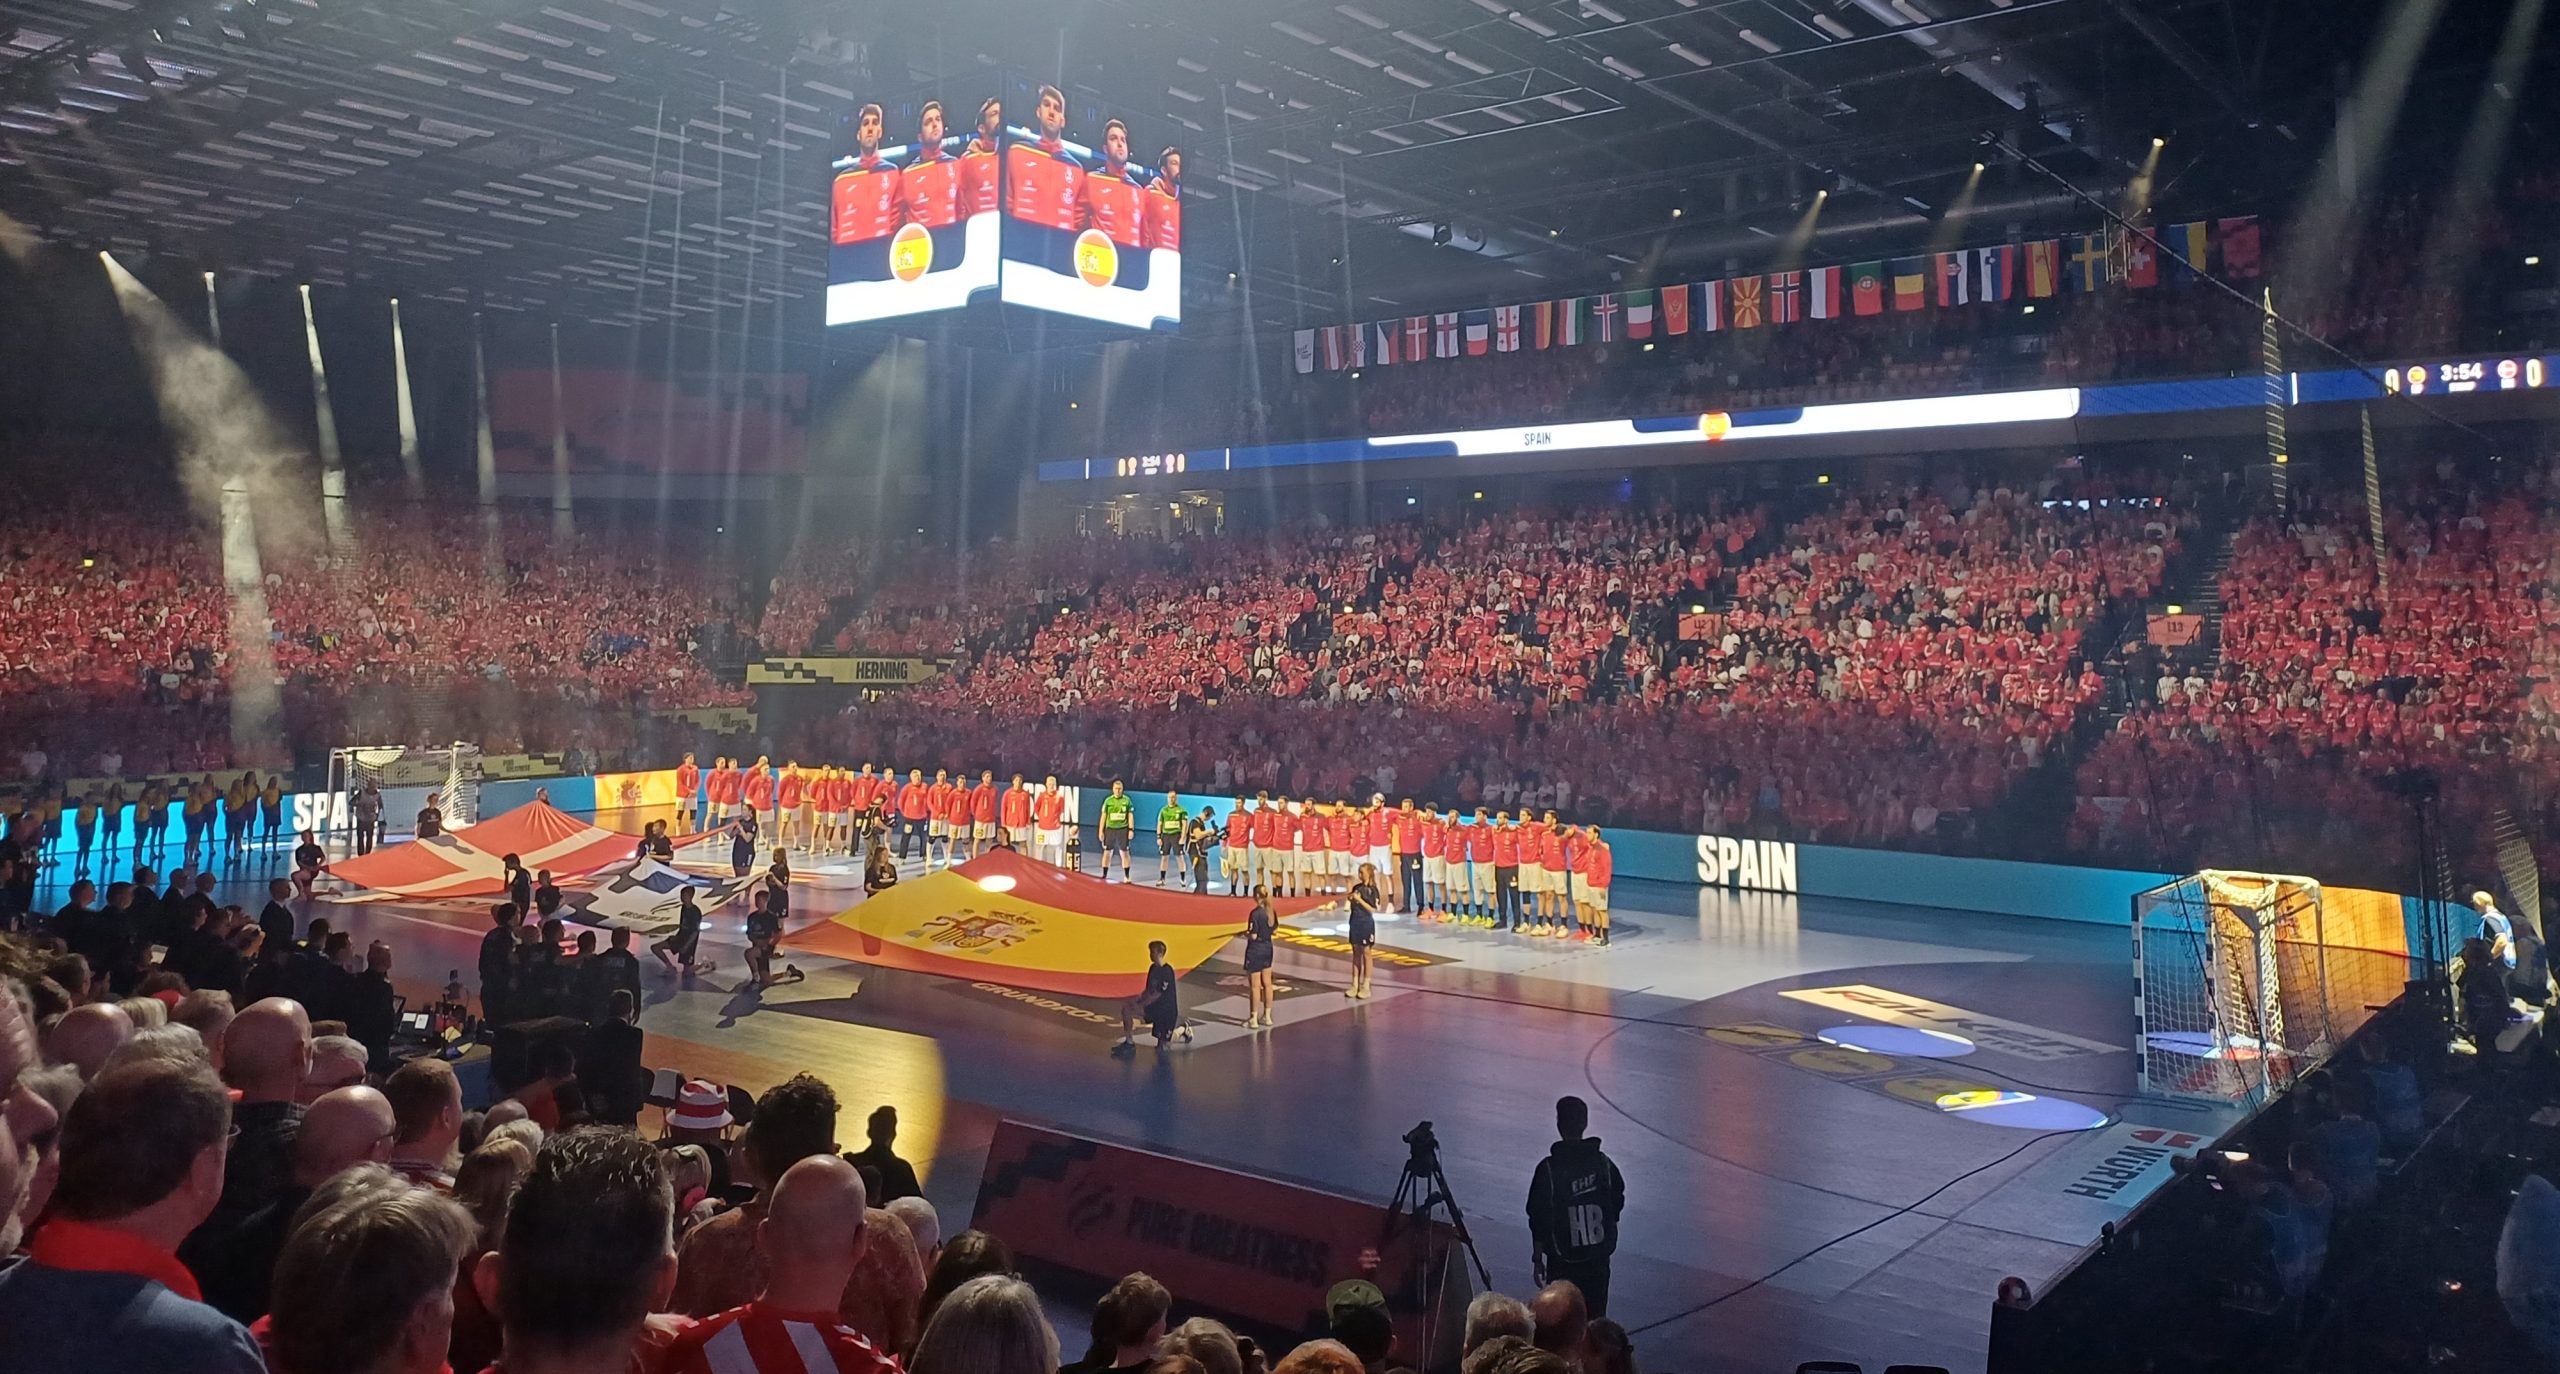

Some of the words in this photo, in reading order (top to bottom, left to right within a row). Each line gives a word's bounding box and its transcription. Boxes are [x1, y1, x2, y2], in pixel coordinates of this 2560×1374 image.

[2440, 362, 2484, 381] 3:54
[1524, 432, 1551, 446] SPAIN
[2167, 621, 2183, 632] 113
[856, 661, 908, 680] HERNING
[292, 791, 357, 832] SPA
[1698, 834, 1797, 892] SPAIN
[971, 982, 1115, 1023] GRUNDFOS
[2062, 1145, 2170, 1201] WÜRTH
[1567, 1203, 1605, 1247] HB
